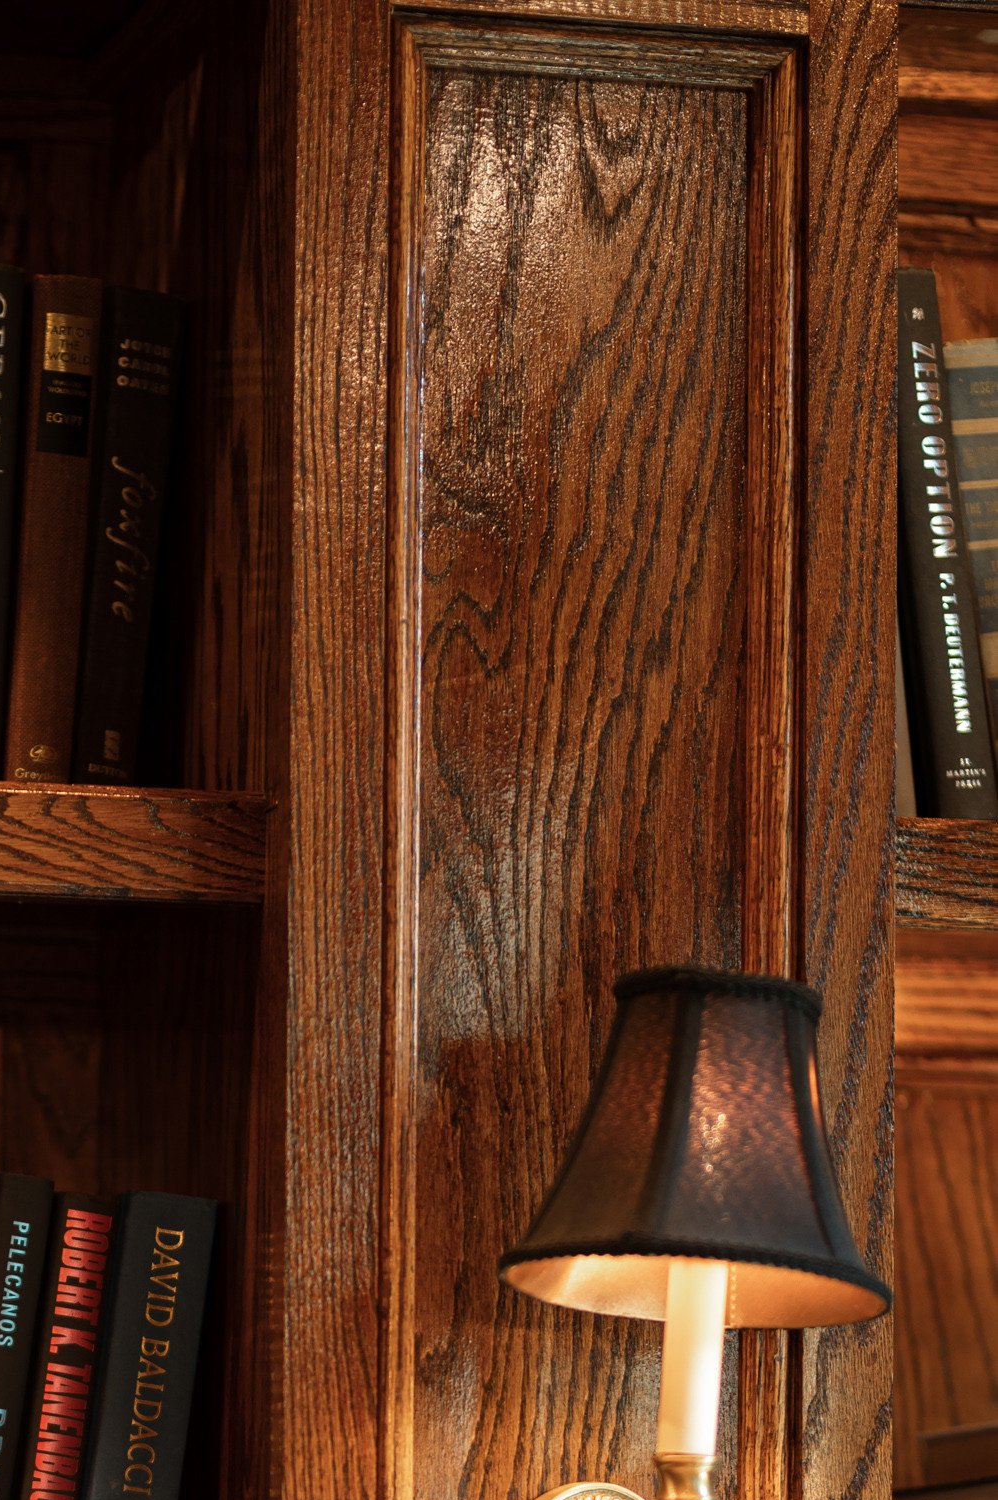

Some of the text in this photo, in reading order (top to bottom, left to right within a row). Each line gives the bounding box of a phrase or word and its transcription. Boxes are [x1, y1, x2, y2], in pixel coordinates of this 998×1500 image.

[50, 325, 72, 337] ART
[59, 338, 81, 351] THE
[48, 350, 91, 367] WORLD
[117, 356, 169, 375] CAROL
[116, 374, 170, 395] OATES
[45, 412, 86, 426] EGYPT
[911, 340, 959, 559] ZERO OPTION
[939, 572, 973, 735] P. T. DEUTERMANN
[53, 1208, 113, 1327] ROBERT
[48, 1325, 97, 1355] K.
[121, 1225, 186, 1497] DAVID BALDACCI
